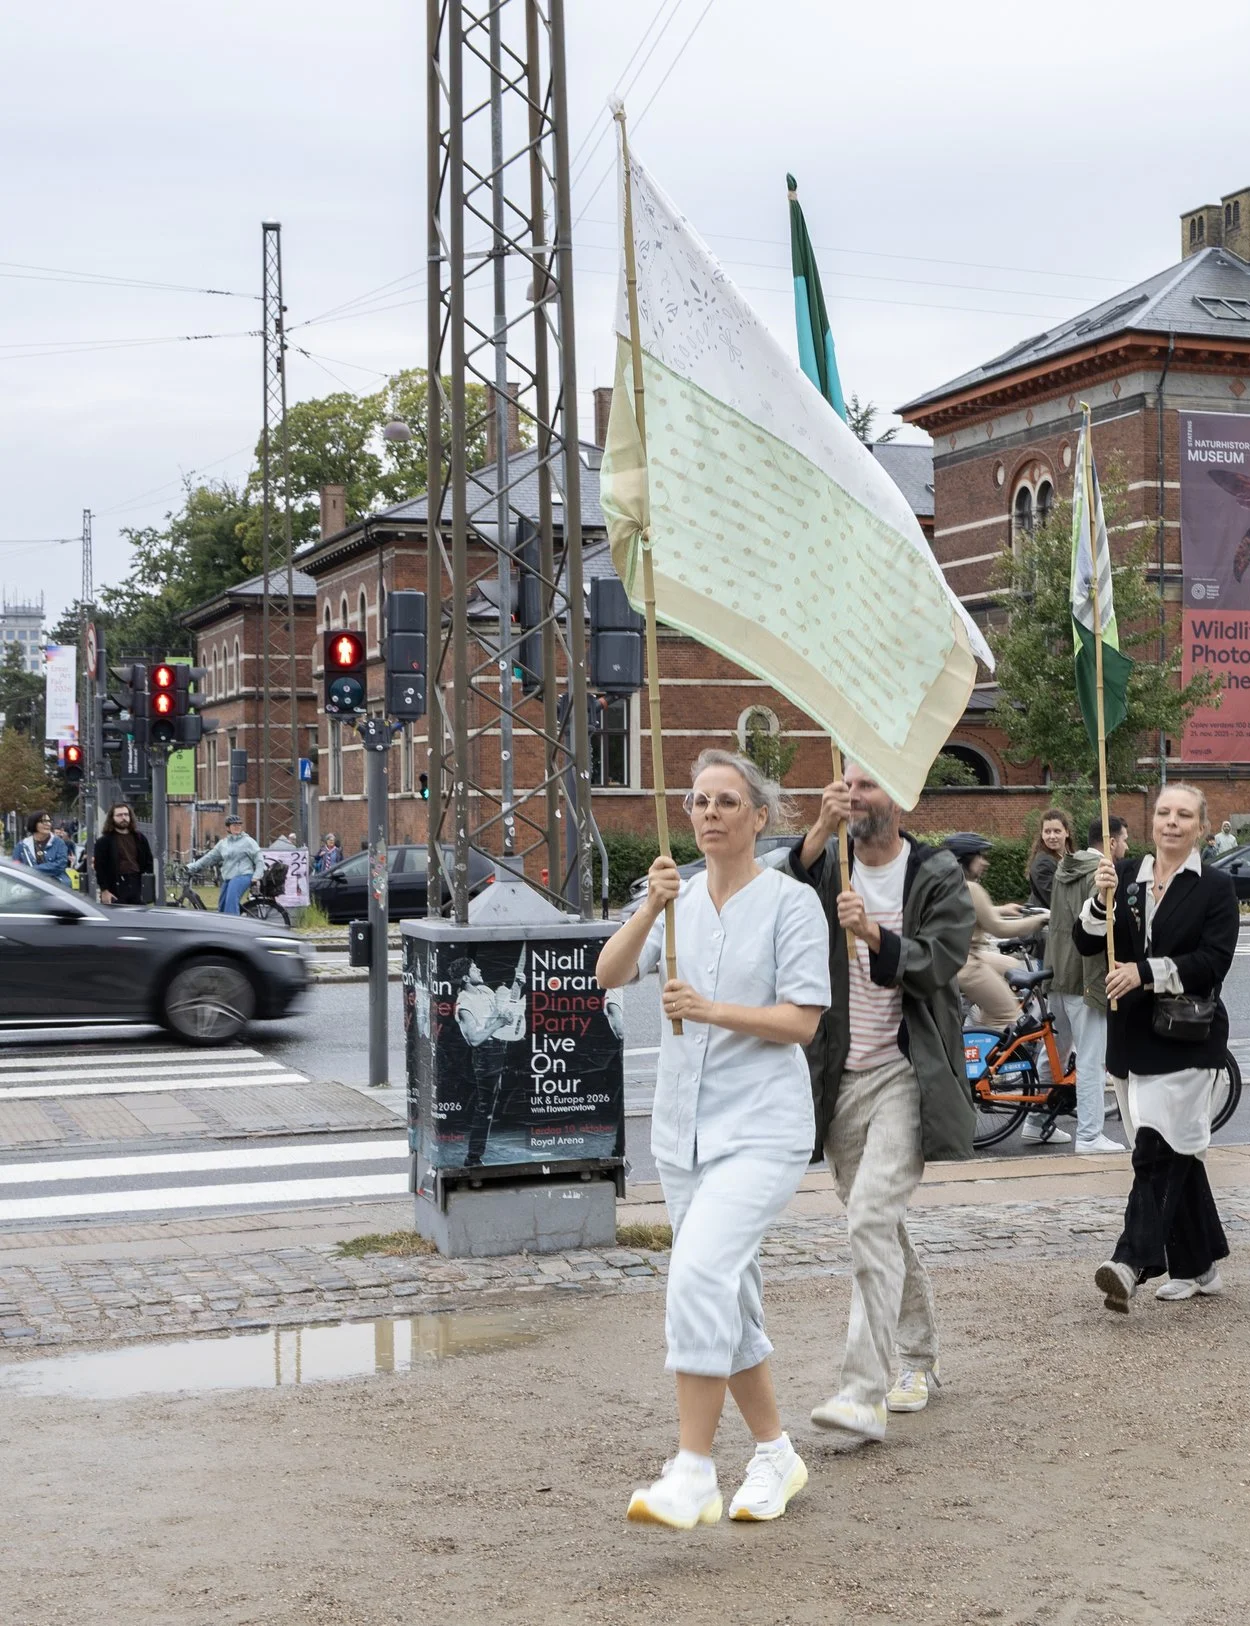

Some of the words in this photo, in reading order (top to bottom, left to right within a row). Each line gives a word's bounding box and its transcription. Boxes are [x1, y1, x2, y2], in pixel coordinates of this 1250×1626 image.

[1187, 449, 1245, 464] MUSEUM
[532, 948, 585, 970] Niall
[532, 971, 600, 991] Horan
[532, 992, 609, 1012] Dinner
[532, 1012, 592, 1036] Party
[532, 1033, 576, 1053] Live
[531, 1053, 566, 1073] On
[964, 1049, 977, 1058] FF
[531, 1074, 581, 1094] Tour
[438, 1102, 462, 1111] 2026
[547, 1104, 596, 1113] flowerovlove
[554, 1096, 584, 1105] Europe
[587, 1094, 610, 1102] 2026
[531, 1137, 555, 1148] Royal
[557, 1137, 584, 1145] Arena
